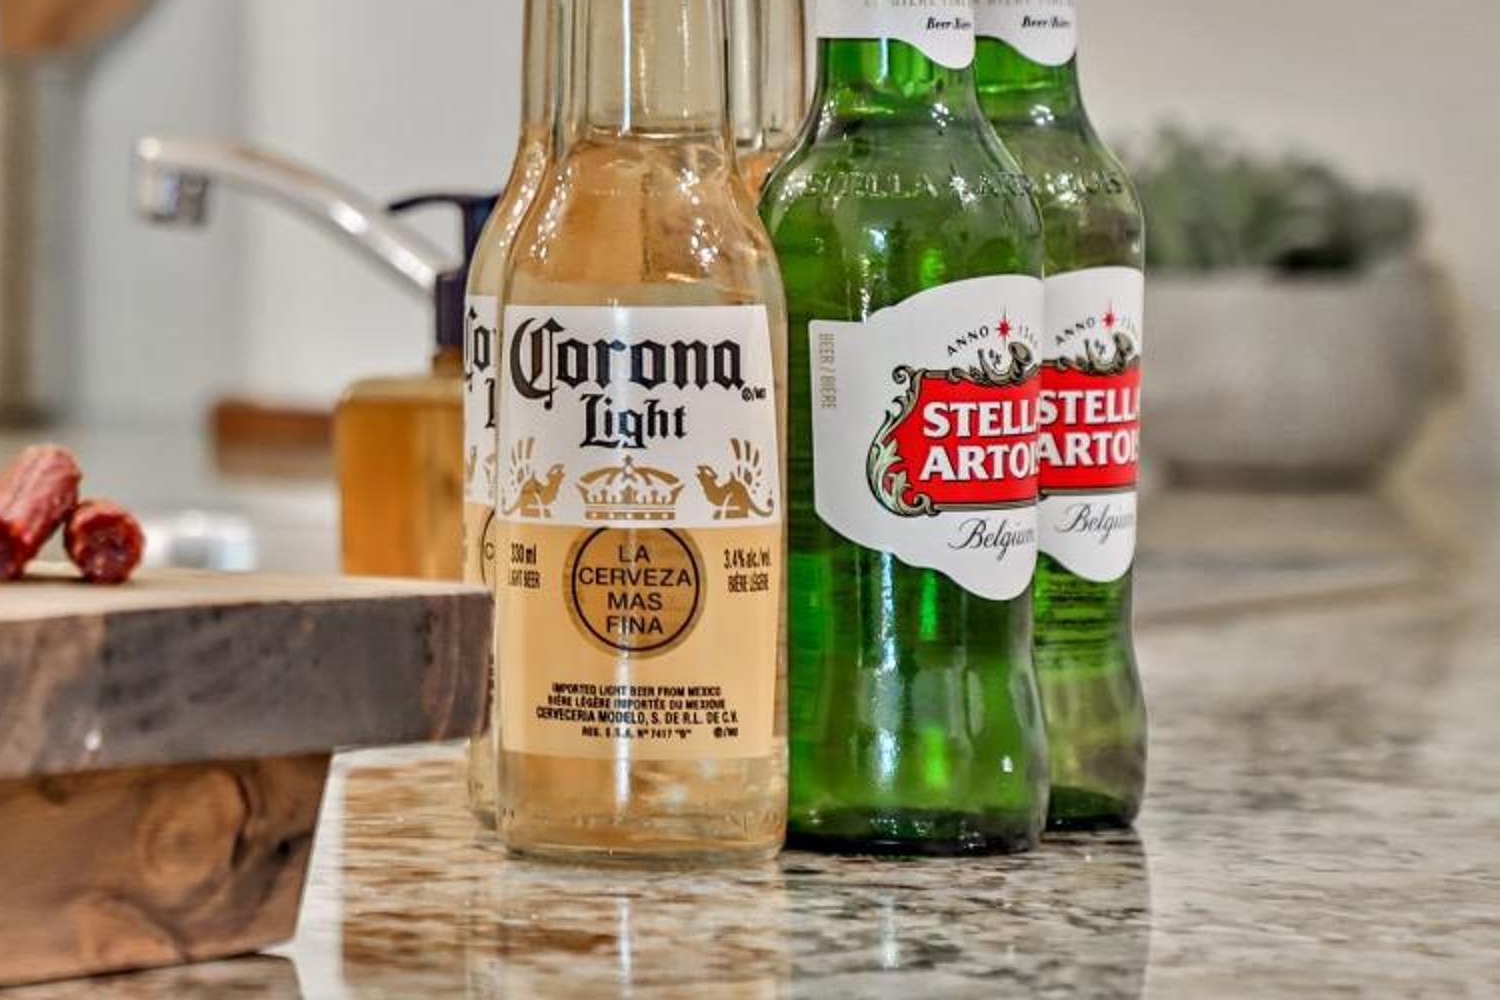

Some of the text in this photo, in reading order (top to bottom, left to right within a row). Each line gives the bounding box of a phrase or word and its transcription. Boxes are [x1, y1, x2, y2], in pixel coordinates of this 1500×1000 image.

[947, 324, 990, 357] ANNO
[1055, 316, 1096, 346] ANNO
[510, 316, 746, 411] Corona
[580, 393, 688, 449] Light
[922, 397, 1039, 438] STELL
[1037, 427, 1140, 467] ARTOI
[919, 441, 1039, 481] ARTOI
[618, 545, 651, 563] LA
[578, 567, 693, 587] CERVEZA
[607, 592, 663, 611] MAS
[606, 615, 664, 634] FINA
[552, 683, 722, 697] IMPORTED LIGHT BEER FROM MEXICO
[669, 699, 683, 710] DU
[597, 710, 649, 725] MODELO,
[665, 711, 681, 724] DE
[706, 711, 721, 724] DE
